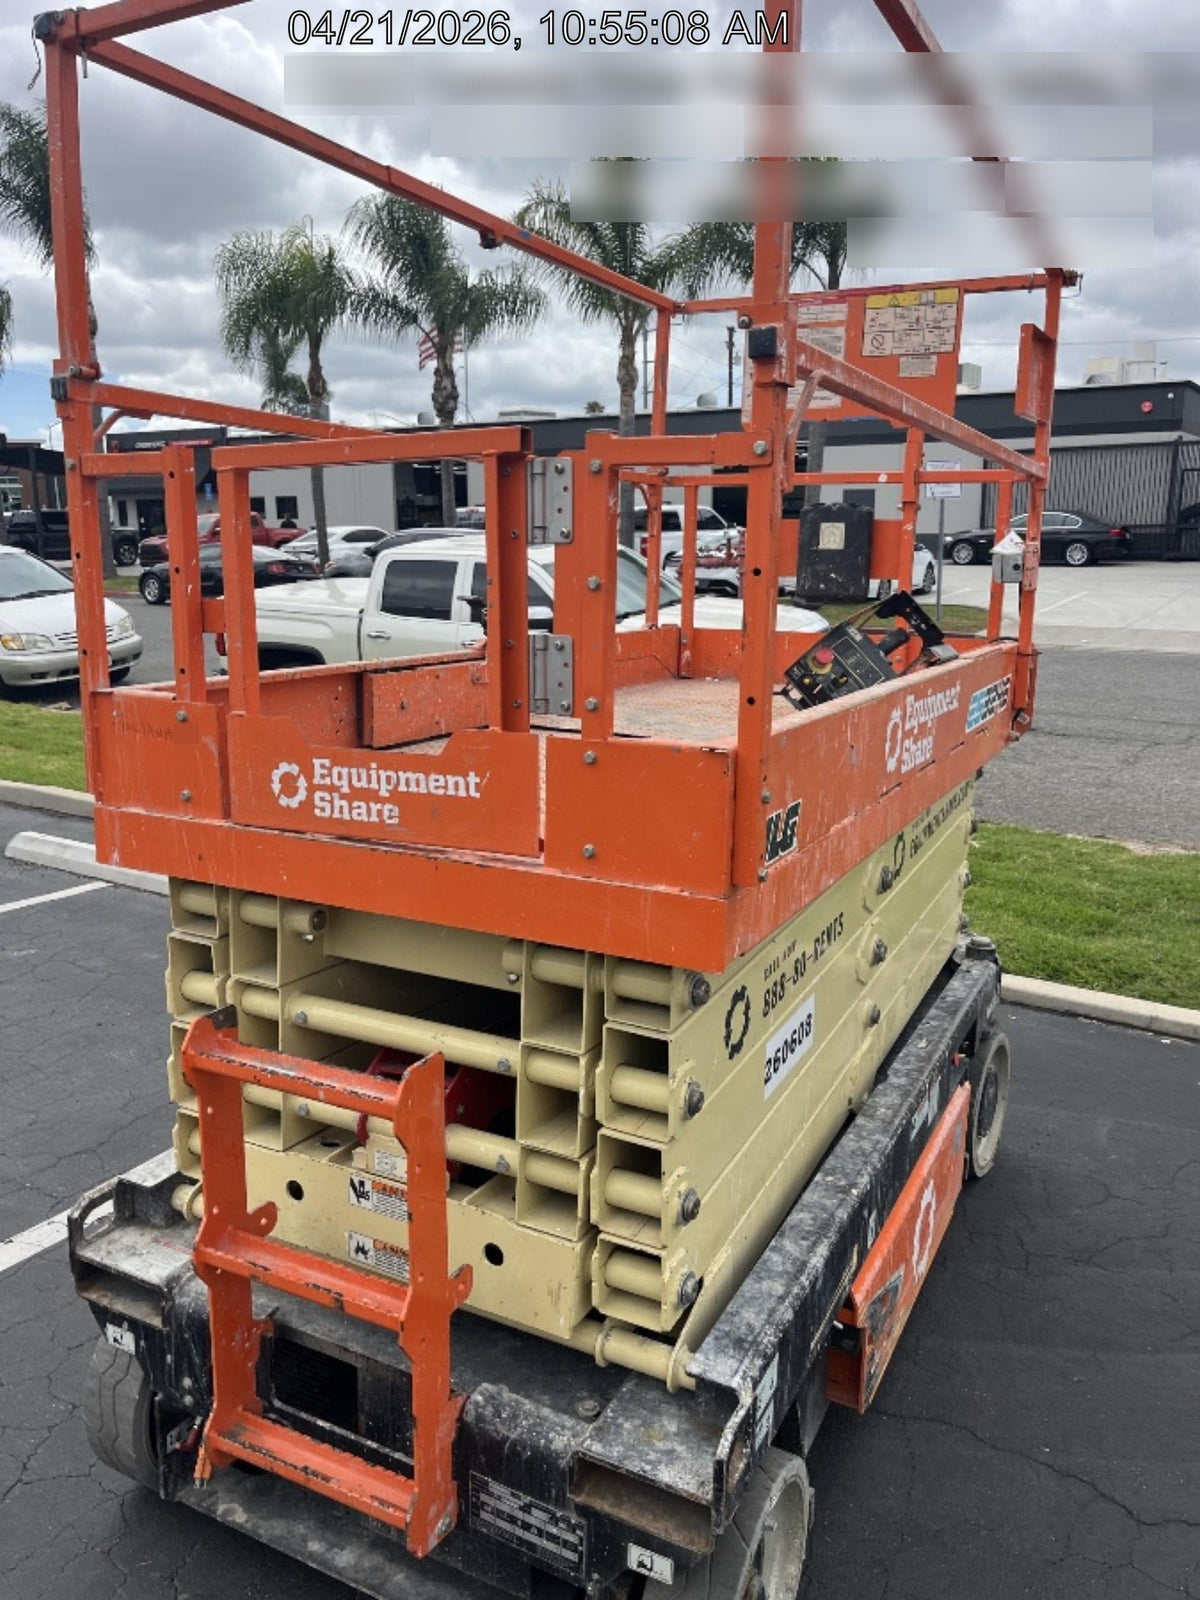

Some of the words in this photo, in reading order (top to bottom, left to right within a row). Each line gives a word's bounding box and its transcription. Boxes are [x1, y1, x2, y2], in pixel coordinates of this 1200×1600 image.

[905, 680, 961, 735] Equipment
[901, 735, 934, 775] Share
[312, 757, 481, 798] Equipment
[313, 790, 400, 824] Share
[764, 1012, 813, 1087] 260608
